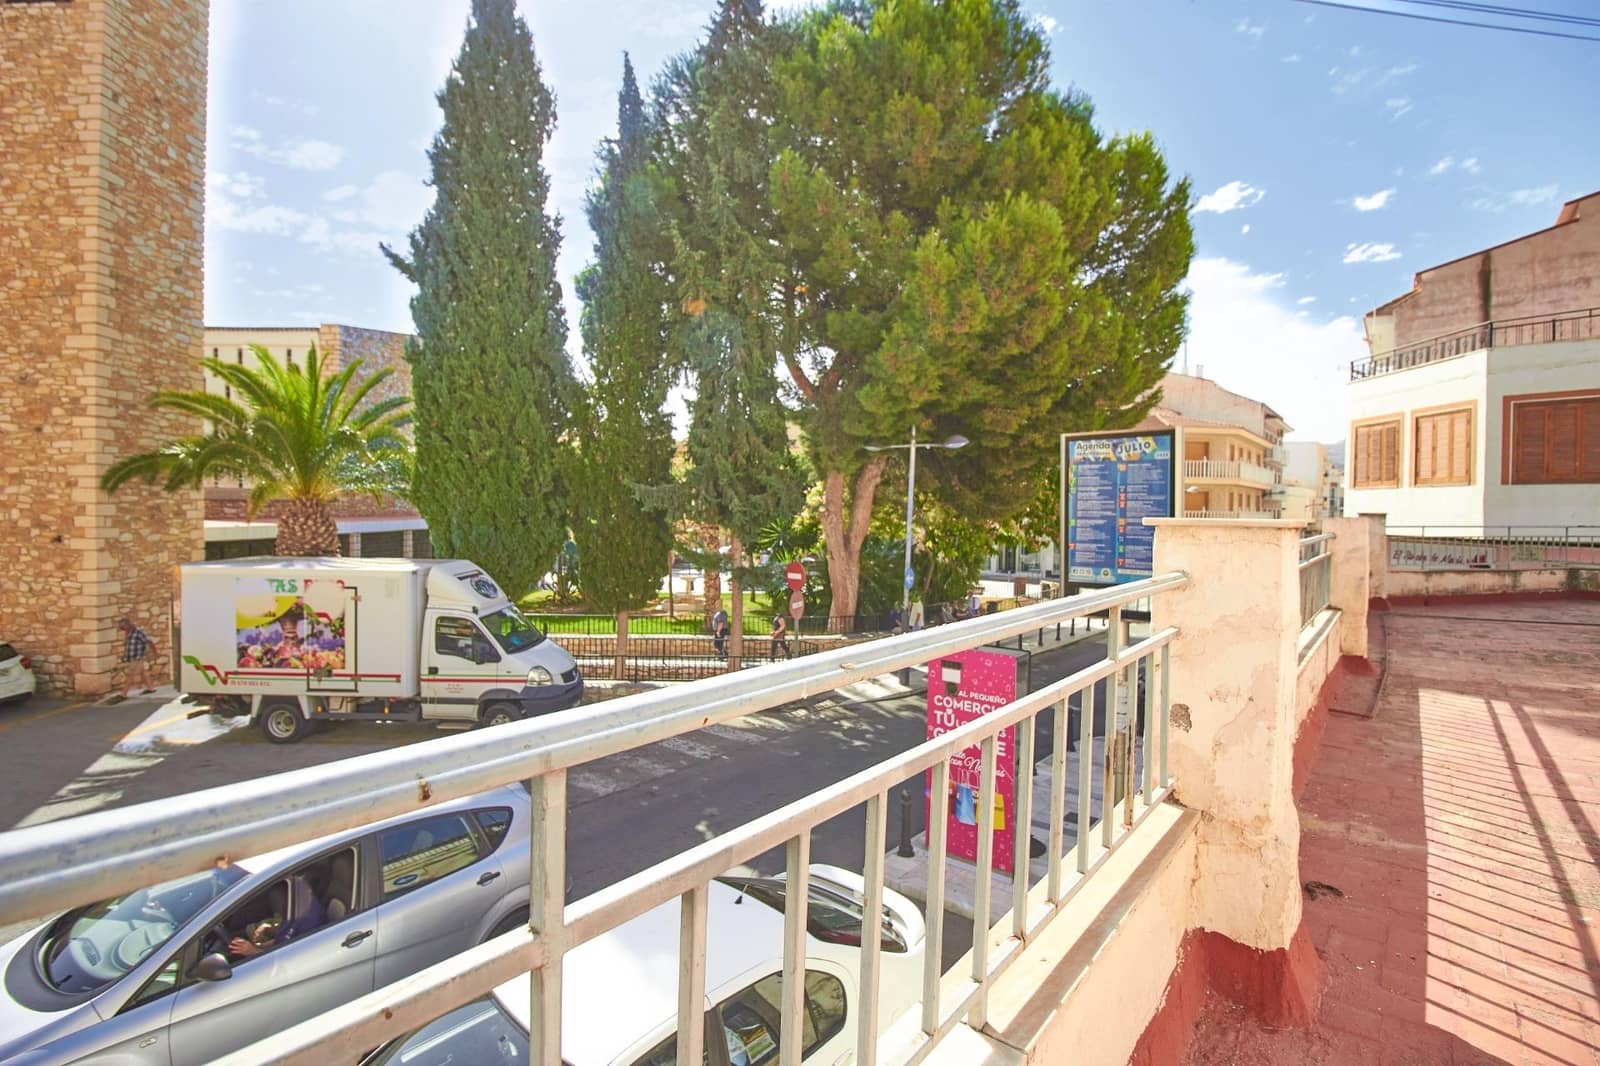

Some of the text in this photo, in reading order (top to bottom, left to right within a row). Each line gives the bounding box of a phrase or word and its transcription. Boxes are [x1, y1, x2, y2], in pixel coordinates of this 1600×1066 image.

[1076, 442, 1111, 451] Agenda
[1117, 441, 1151, 454] JULIO
[958, 690, 1007, 705] AL PEQUEÑO
[934, 695, 997, 716] COMERCI
